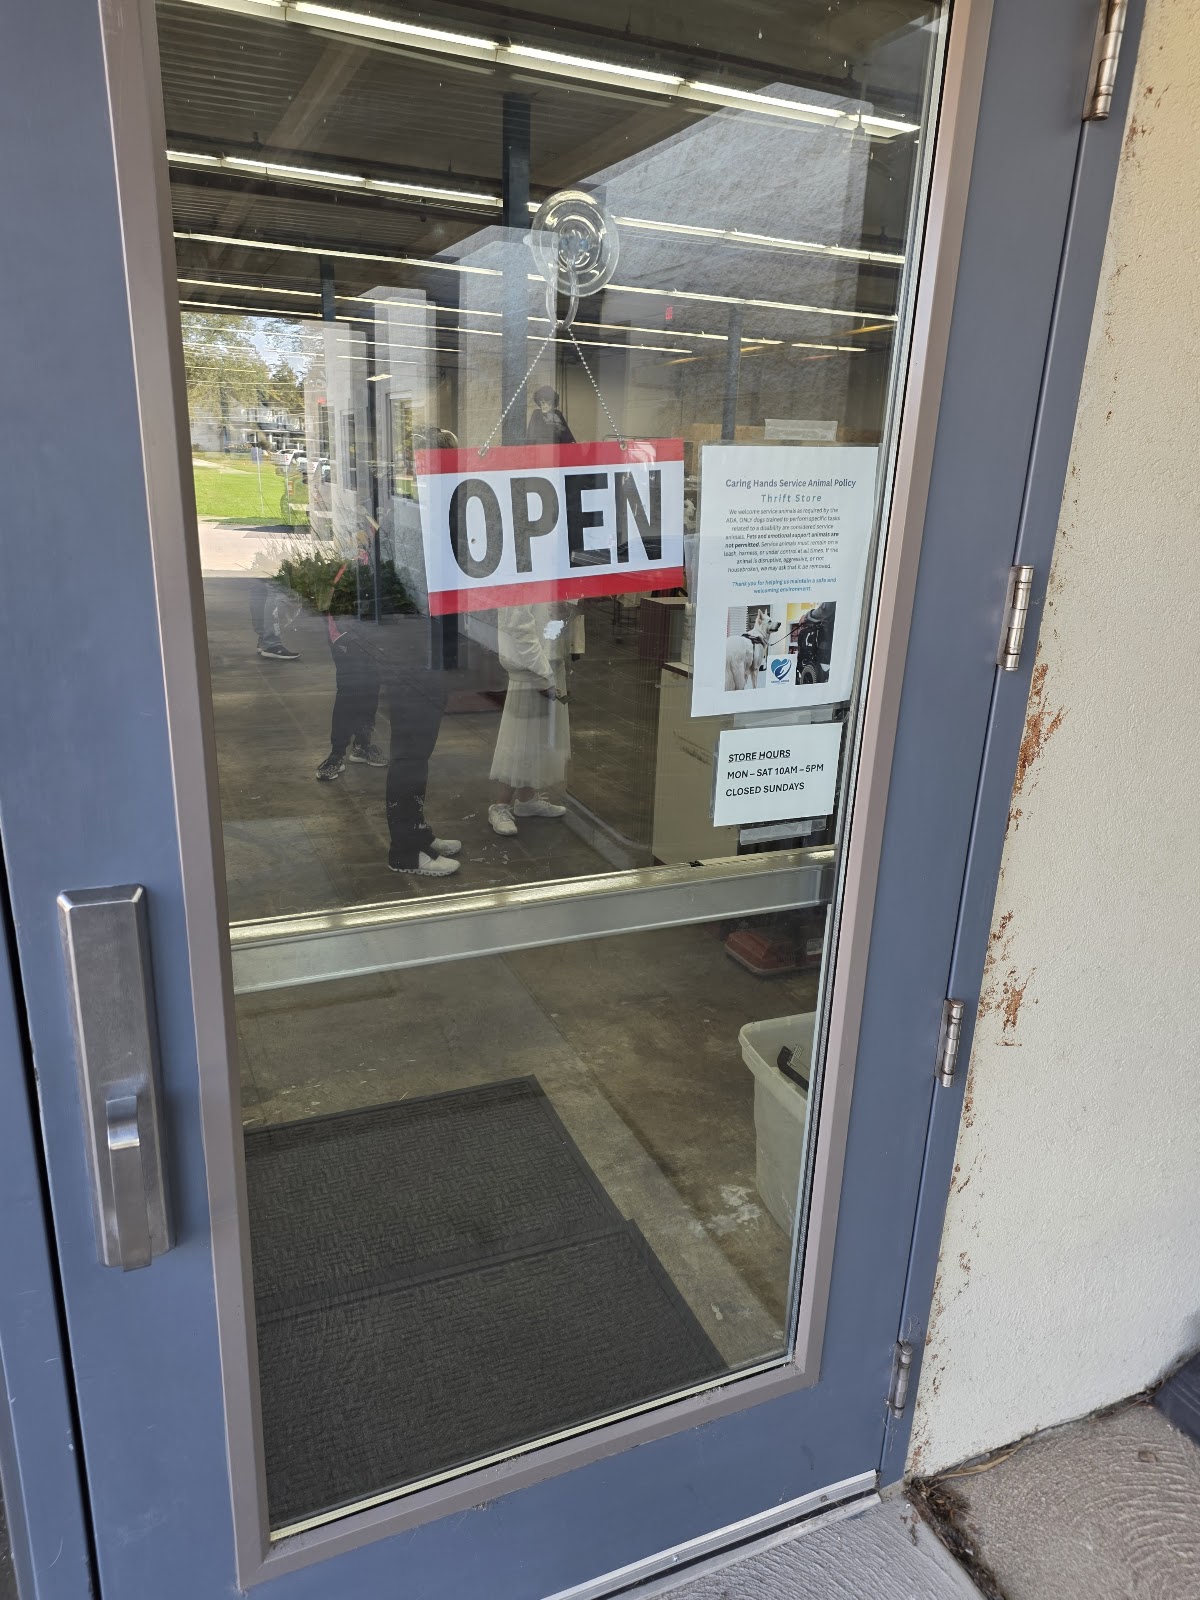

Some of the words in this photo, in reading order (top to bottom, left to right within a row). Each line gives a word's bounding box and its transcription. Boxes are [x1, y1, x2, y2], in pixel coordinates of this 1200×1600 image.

[726, 480, 751, 489] Caring
[753, 479, 778, 488] Hands
[780, 479, 806, 487] Service
[808, 479, 832, 487] Animal
[834, 478, 856, 488] Policy
[761, 494, 791, 502] Thrift
[795, 494, 822, 502] Store
[448, 470, 662, 579] OPEN
[728, 752, 757, 763] STORE
[759, 750, 791, 760] HOURS
[727, 770, 748, 780] MON
[756, 768, 773, 777] SAT
[775, 766, 798, 776] 10AM
[806, 764, 824, 773] 5PM
[726, 786, 761, 796] CLOSED
[764, 782, 805, 794] SUNDAYS
